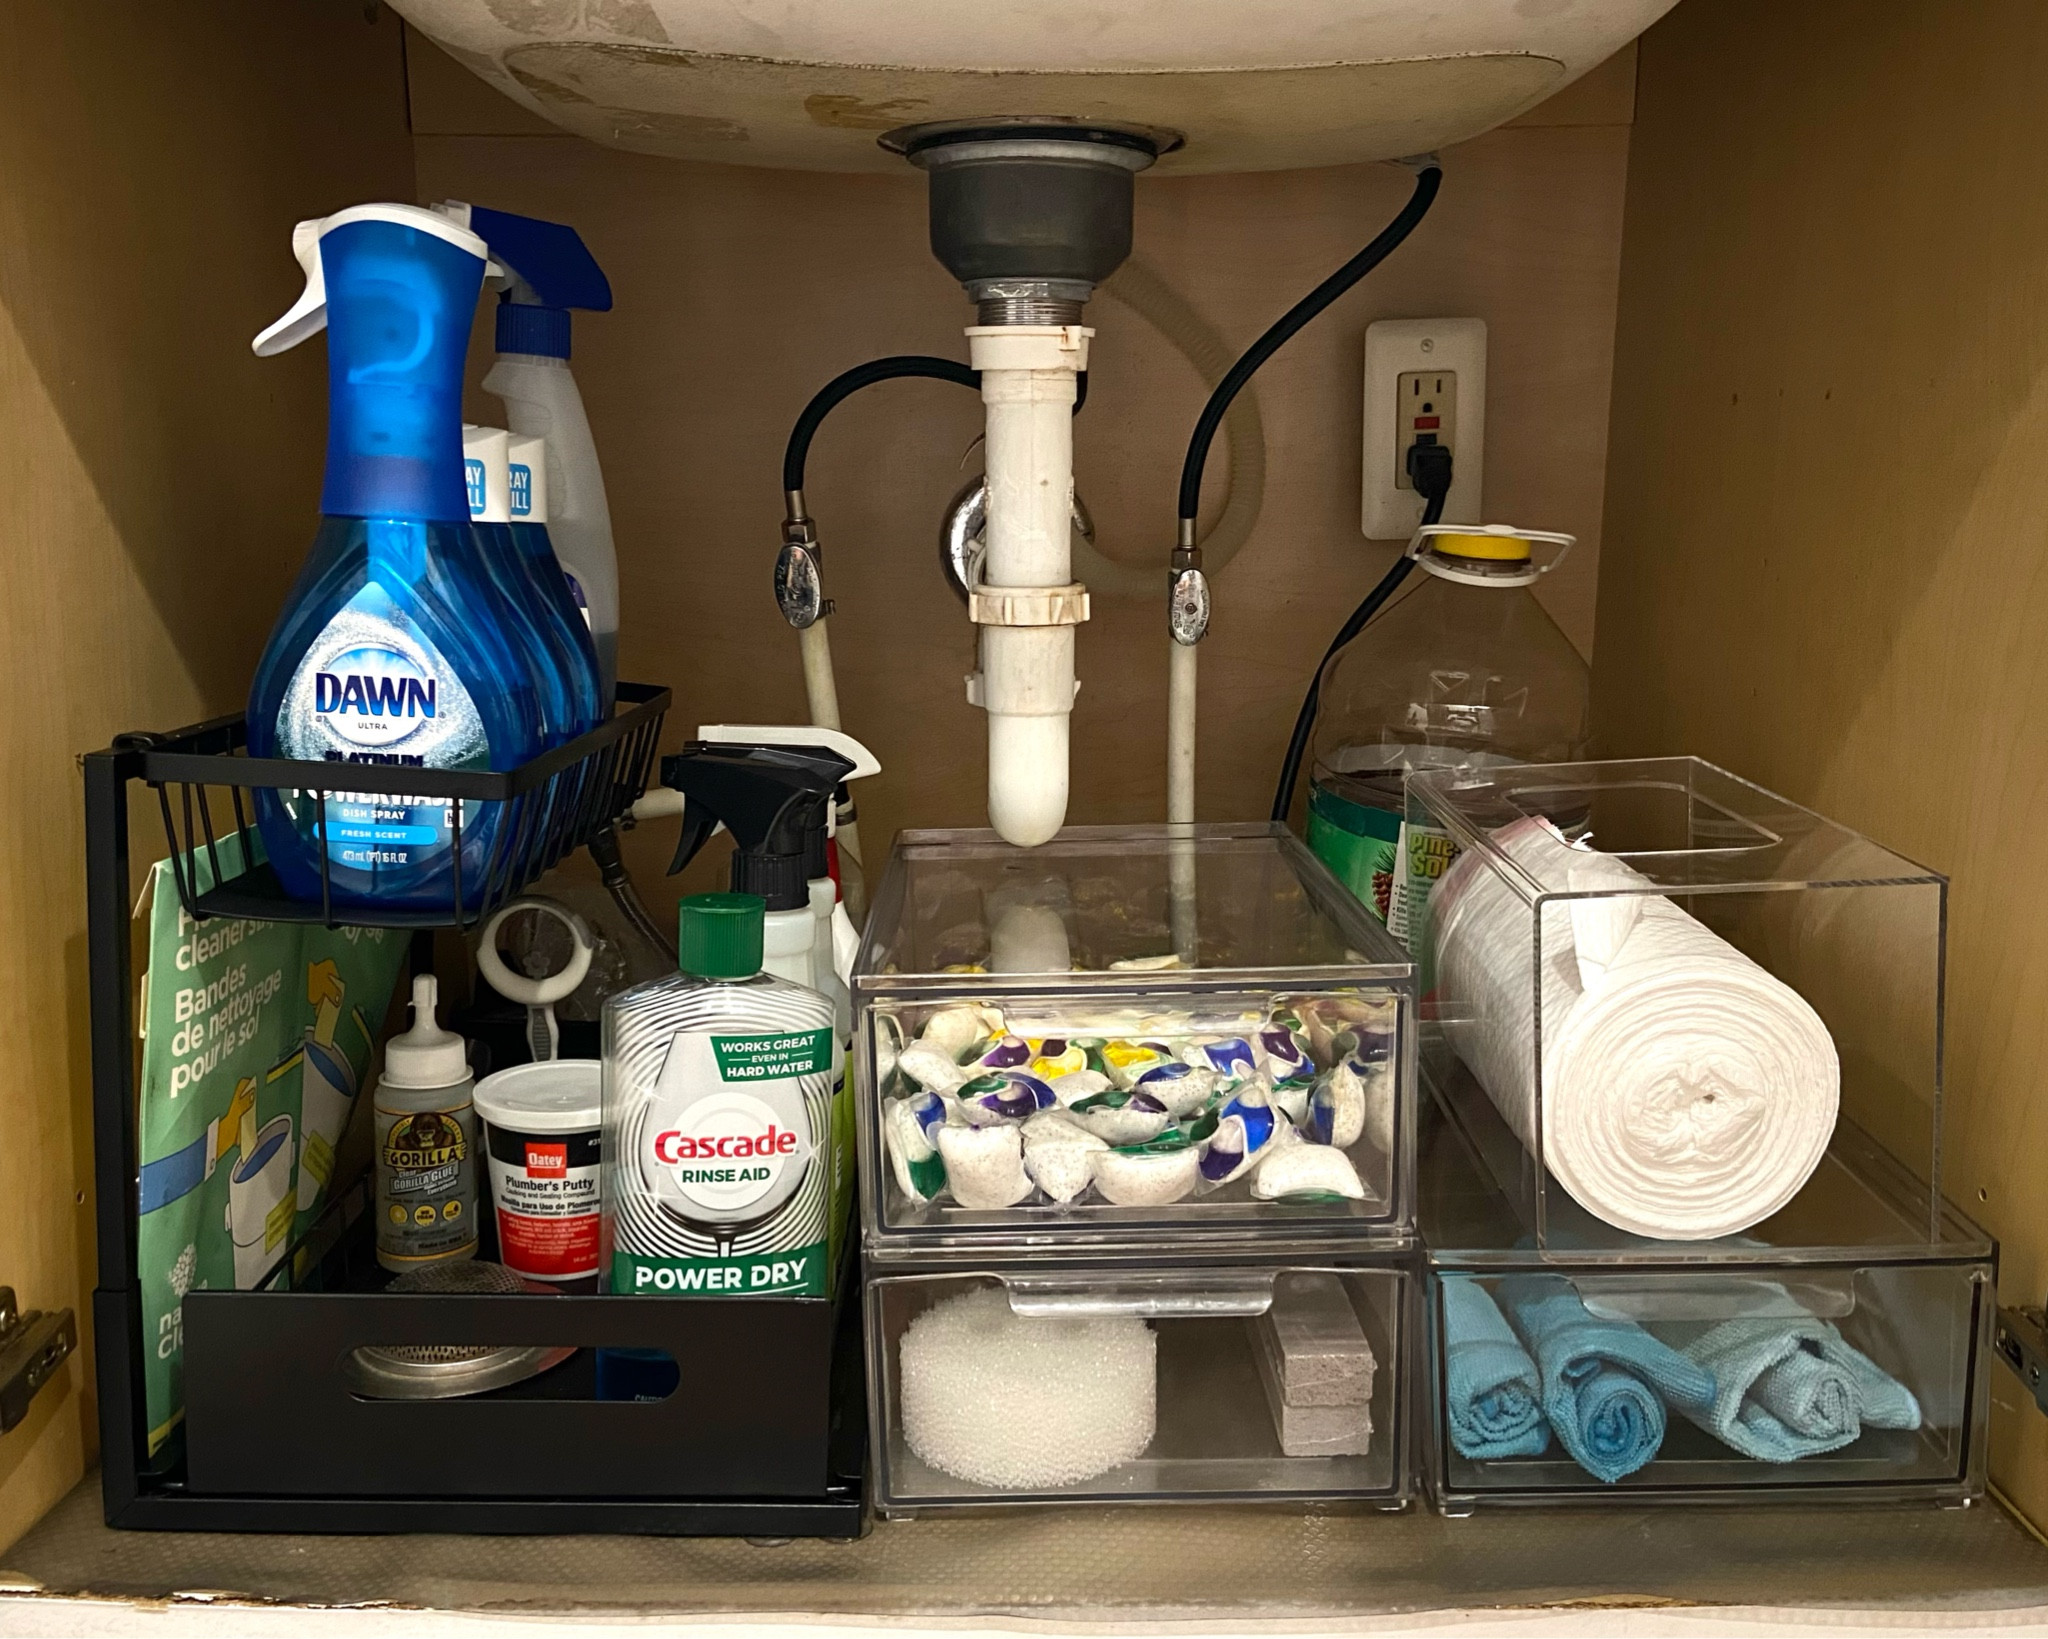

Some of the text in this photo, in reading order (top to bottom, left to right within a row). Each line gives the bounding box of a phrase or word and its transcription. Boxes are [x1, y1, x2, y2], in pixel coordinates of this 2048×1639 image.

[316, 673, 435, 718] DAWN
[358, 722, 388, 730] ULTRA
[342, 809, 406, 820] DISH SPRAY
[341, 829, 407, 840] FRESH SCENT
[175, 920, 247, 971] cleaner
[175, 963, 246, 1024] Bandes
[171, 969, 282, 1057] de nettoyage
[170, 1004, 260, 1099] pour le sol
[720, 1035, 816, 1054] WORKS GREAT
[751, 1053, 789, 1063] EVEN IN
[726, 1060, 814, 1078] HARD WATER
[655, 1125, 797, 1164] Cascade
[390, 1147, 458, 1166] GORILLA
[528, 1152, 563, 1169] Oatey
[394, 1175, 429, 1190] GORILLA
[431, 1166, 454, 1182] GLUE
[505, 1175, 594, 1191] Plumber's Putty
[682, 1167, 771, 1183] RINSE AID
[521, 1201, 537, 1210] para
[539, 1201, 553, 1211] Uso
[555, 1202, 565, 1211] de
[635, 1257, 807, 1290] POWER DRY
